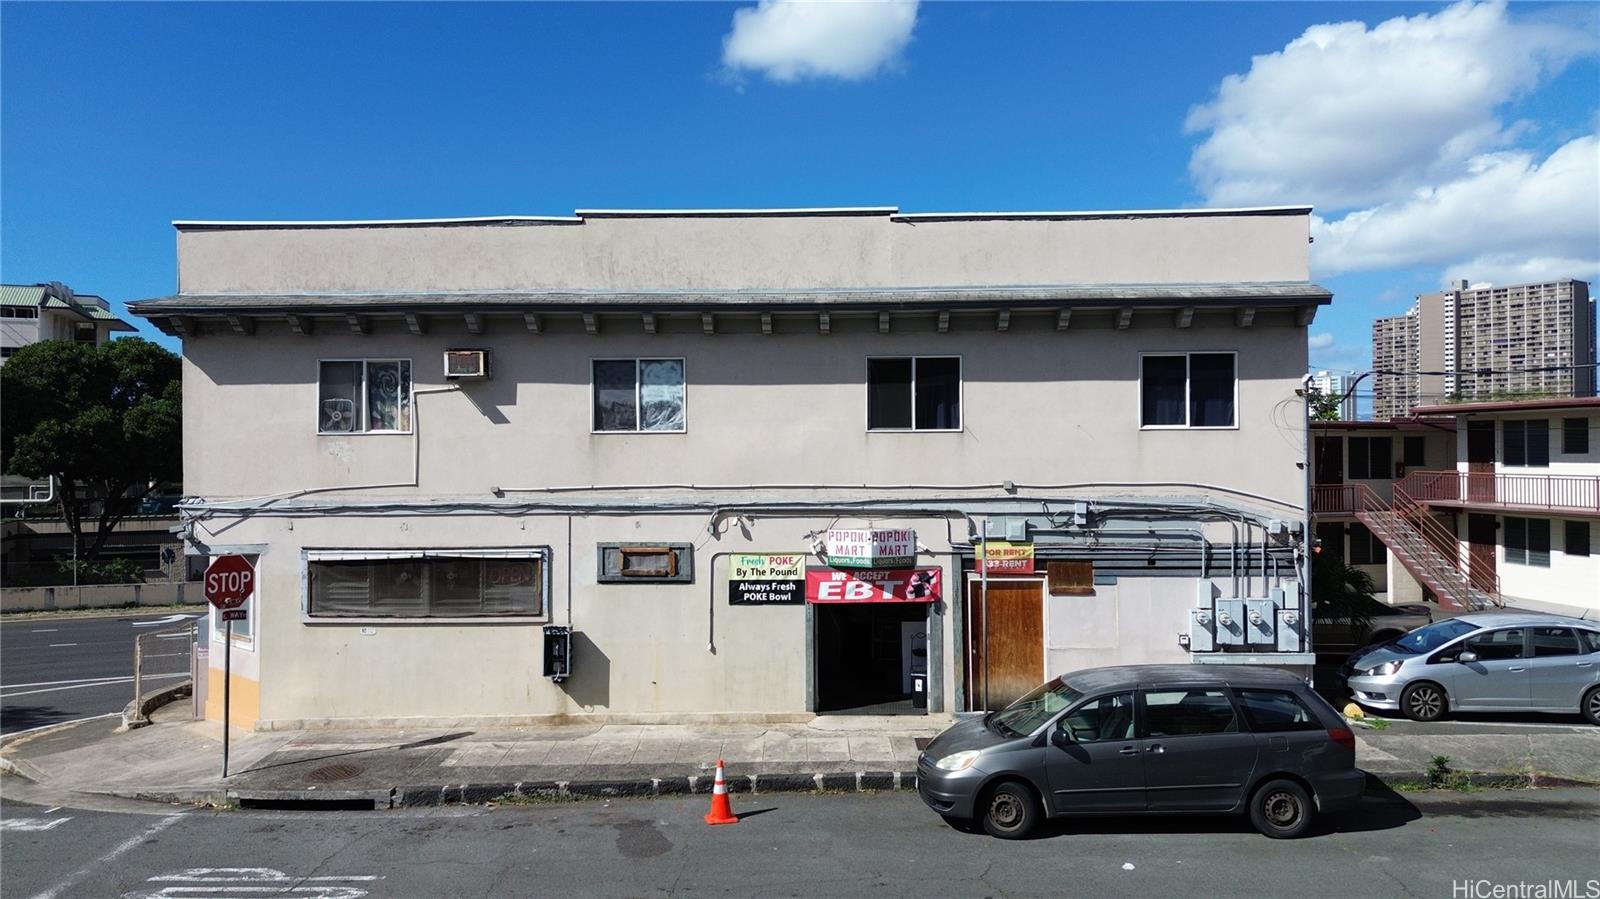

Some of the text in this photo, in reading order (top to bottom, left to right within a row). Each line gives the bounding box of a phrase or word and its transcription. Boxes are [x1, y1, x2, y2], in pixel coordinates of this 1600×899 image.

[828, 530, 867, 543] POPOKI
[872, 530, 911, 543] POPOKI
[835, 545, 865, 556] MART
[879, 545, 909, 556] MART
[1003, 549, 1026, 557] RENT
[740, 556, 794, 566] Fresh POKE
[736, 568, 798, 578] By The Pound
[831, 571, 890, 581] WE ACCEPT
[208, 571, 251, 594] STOP
[739, 583, 796, 592] Always Fresh
[818, 581, 904, 600] EBT
[743, 593, 791, 601] POKE Bowl
